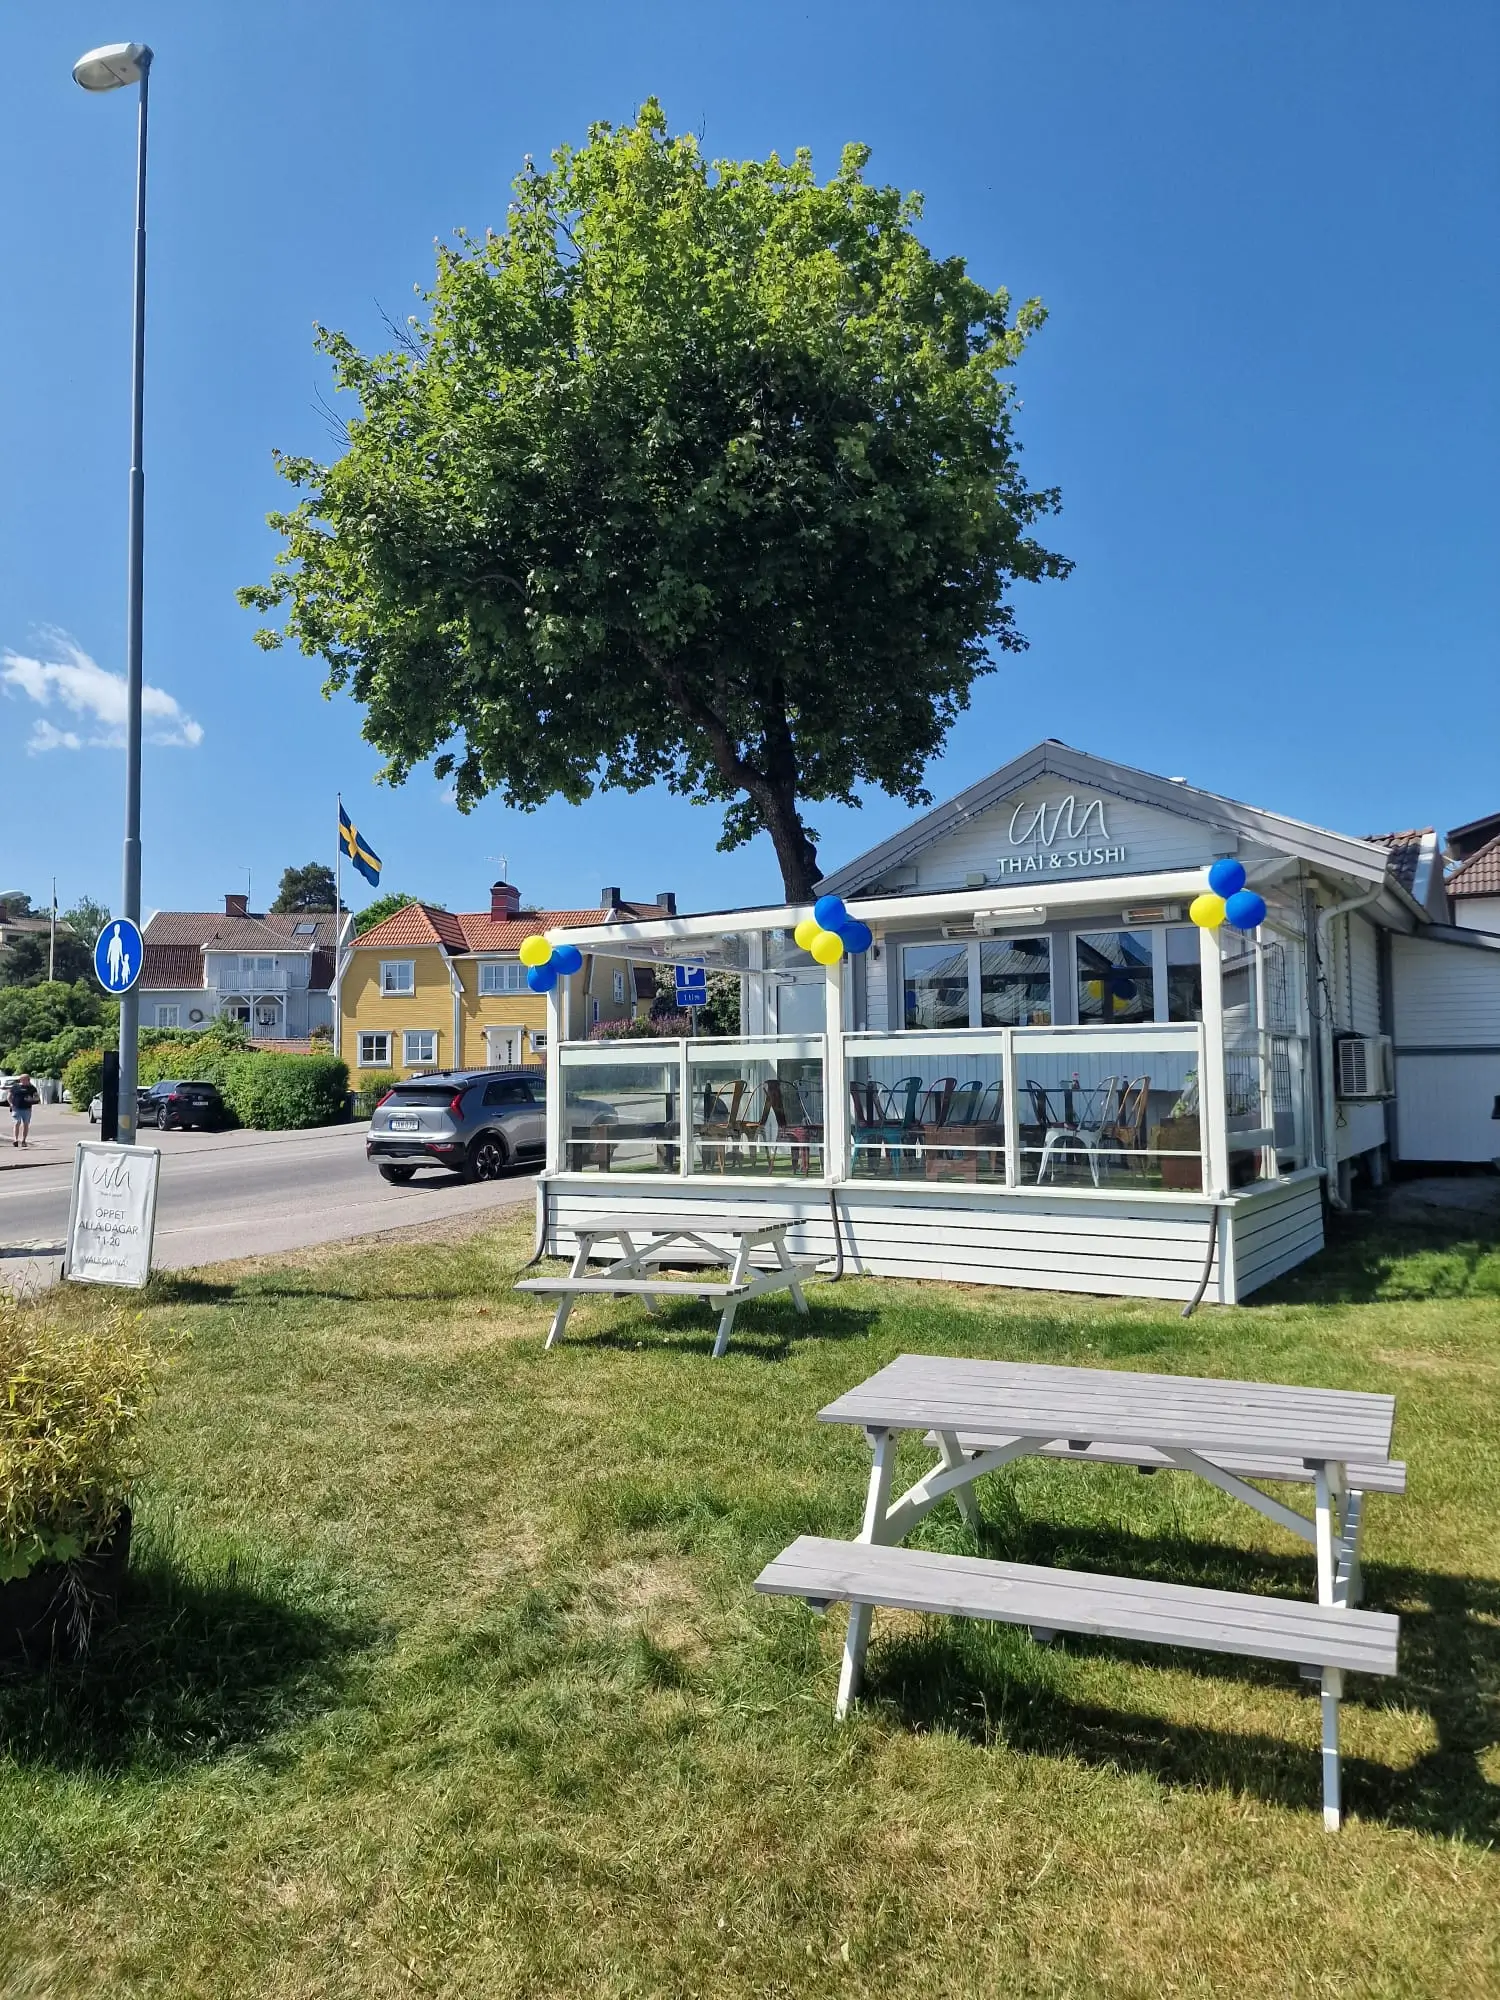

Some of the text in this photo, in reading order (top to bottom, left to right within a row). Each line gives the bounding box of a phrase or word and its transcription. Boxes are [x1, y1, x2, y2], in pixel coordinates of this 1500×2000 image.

[996, 846, 1125, 874] THAI & SUSHI
[683, 965, 698, 985] P
[78, 1220, 139, 1235] ALLA DAGAR
